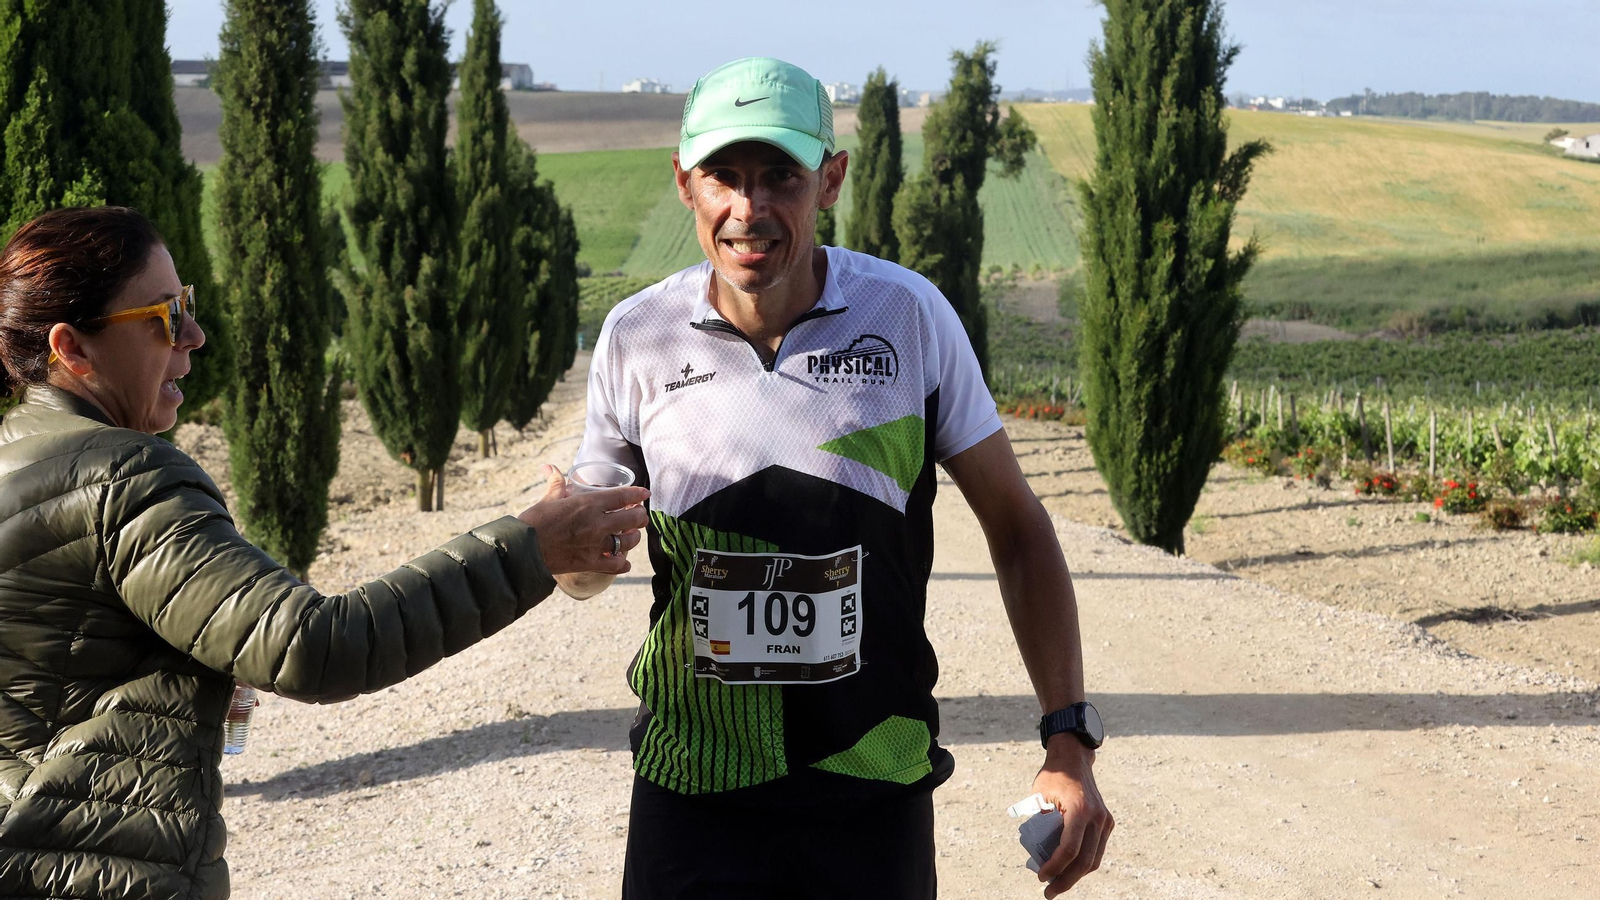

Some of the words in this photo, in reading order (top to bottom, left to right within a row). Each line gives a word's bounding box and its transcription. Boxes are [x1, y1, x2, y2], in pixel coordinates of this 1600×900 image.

[664, 371, 717, 393] TEAMERGY
[862, 378, 885, 386] RUN
[738, 591, 816, 638] 109
[766, 644, 801, 655] FRAN
